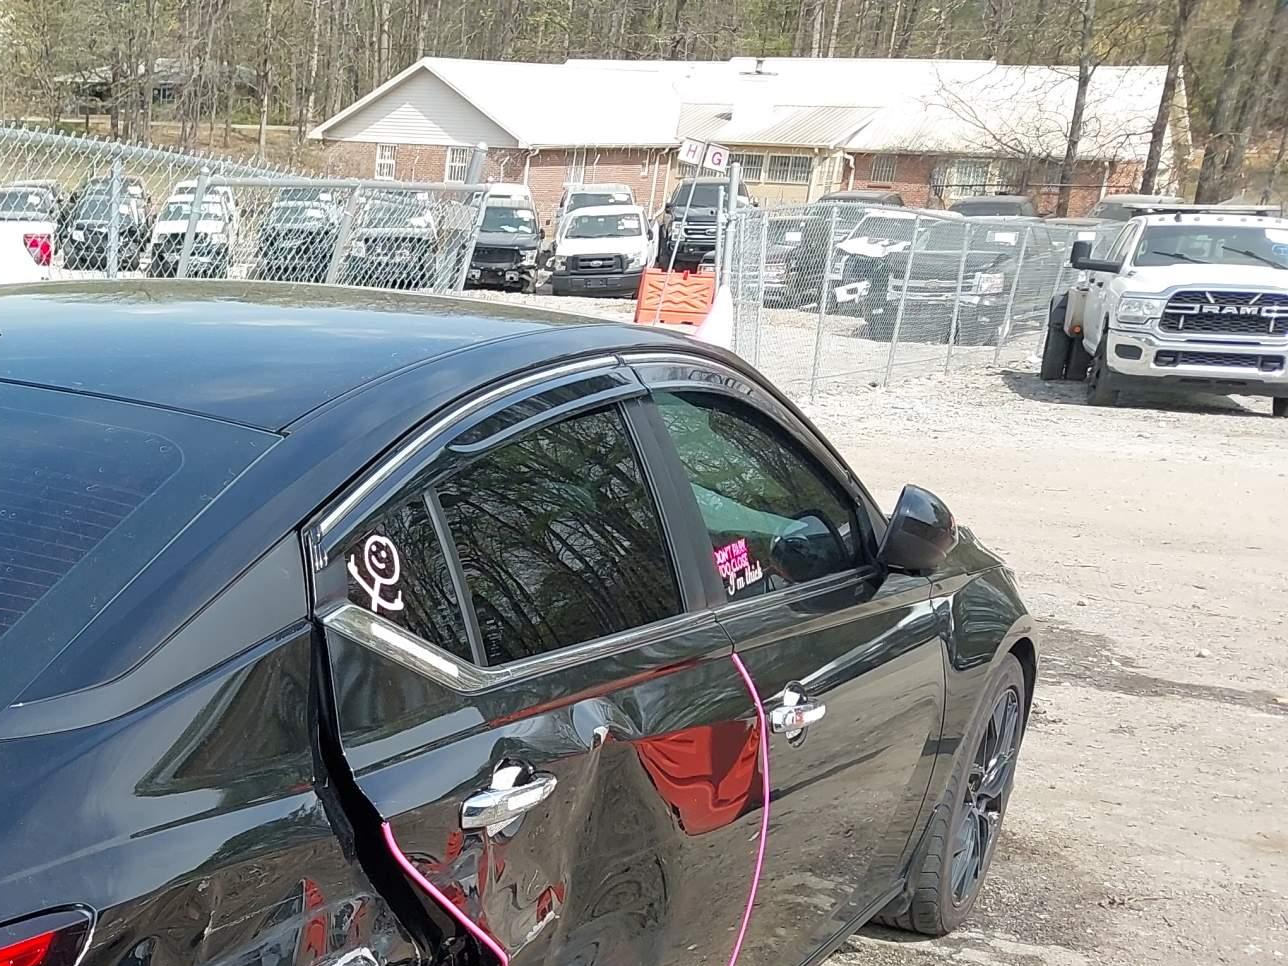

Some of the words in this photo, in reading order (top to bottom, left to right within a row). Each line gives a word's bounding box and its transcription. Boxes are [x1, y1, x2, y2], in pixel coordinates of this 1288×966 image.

[686, 144, 698, 159] H
[711, 151, 723, 166] G
[1201, 304, 1259, 315] RAM
